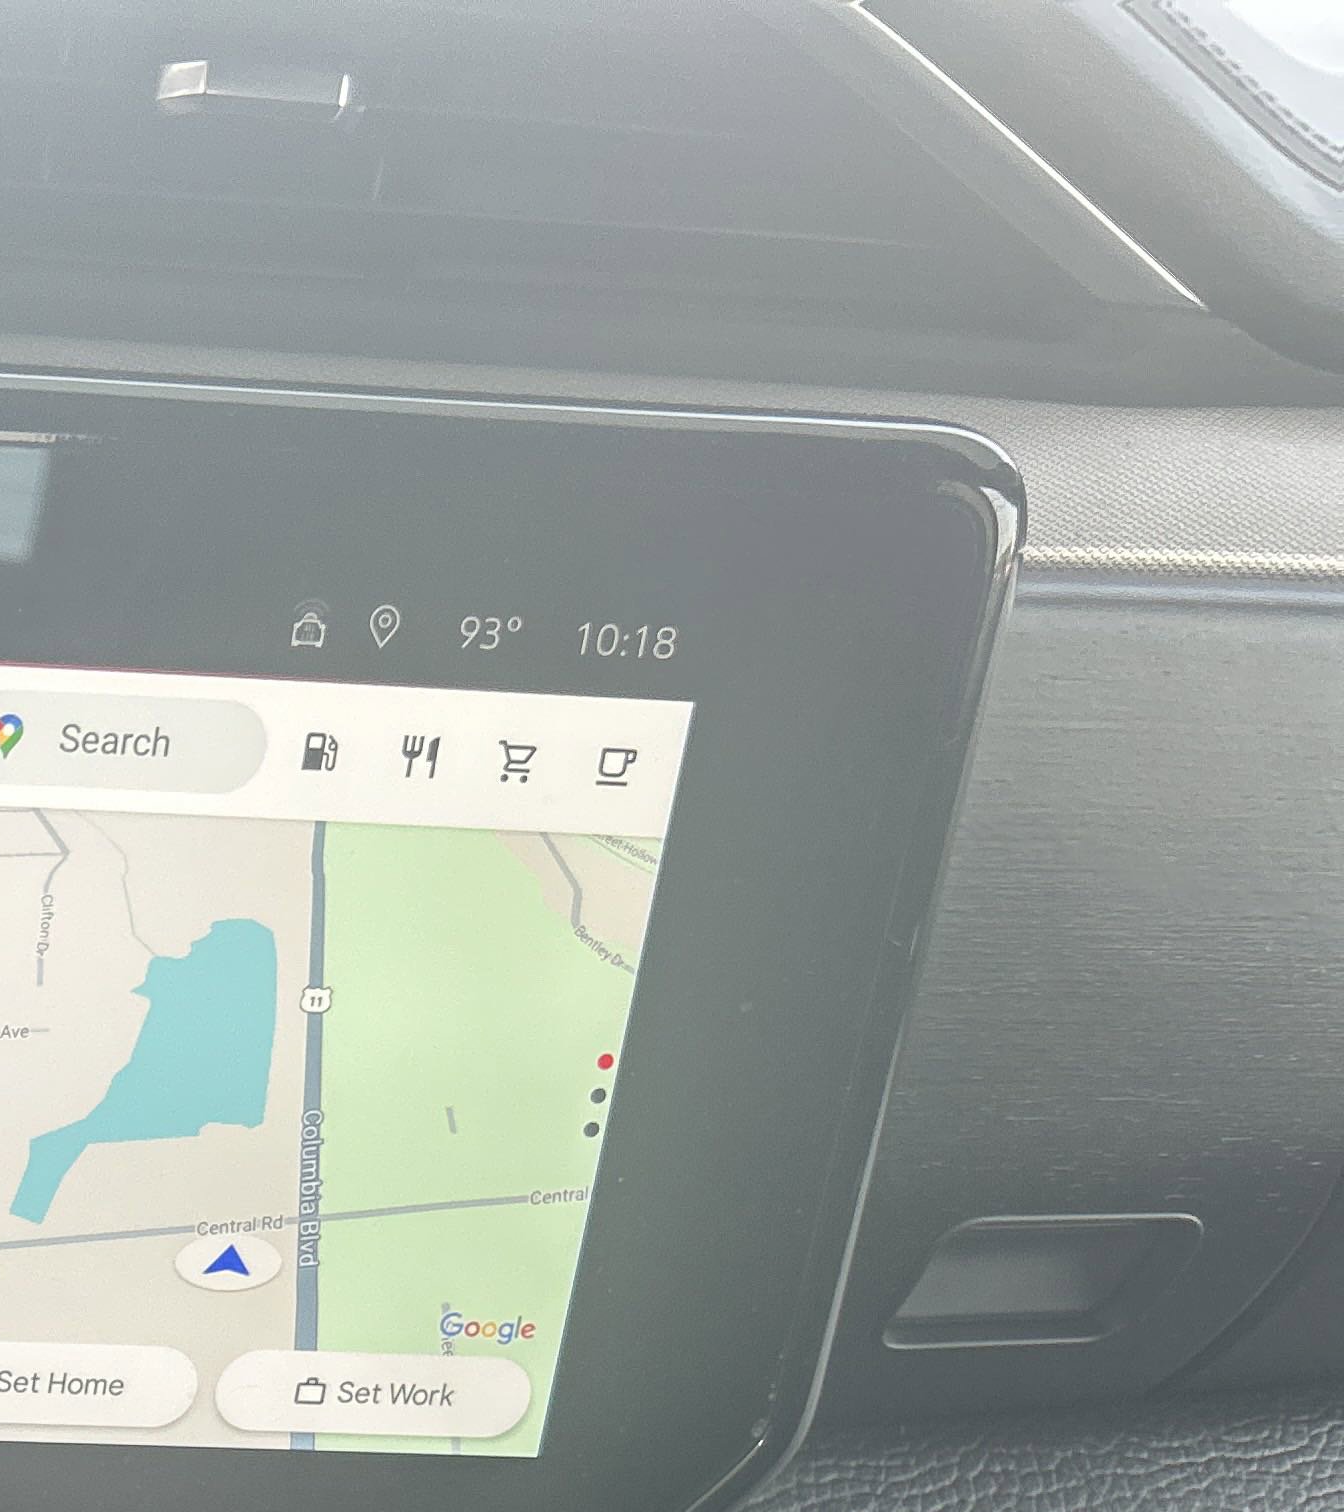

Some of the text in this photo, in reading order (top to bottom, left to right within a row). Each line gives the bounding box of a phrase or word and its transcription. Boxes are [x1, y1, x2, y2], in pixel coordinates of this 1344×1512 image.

[577, 621, 677, 660] 10:18
[59, 723, 171, 758] Search
[574, 924, 614, 961] Bentley
[0, 1024, 30, 1040] Ave
[298, 1109, 324, 1267] Columbia Blvd
[529, 1186, 590, 1206] Central
[196, 1214, 284, 1236] Central Rd
[440, 1312, 536, 1345] Google
[48, 1371, 125, 1397] Home
[336, 1380, 455, 1407] Set Work
